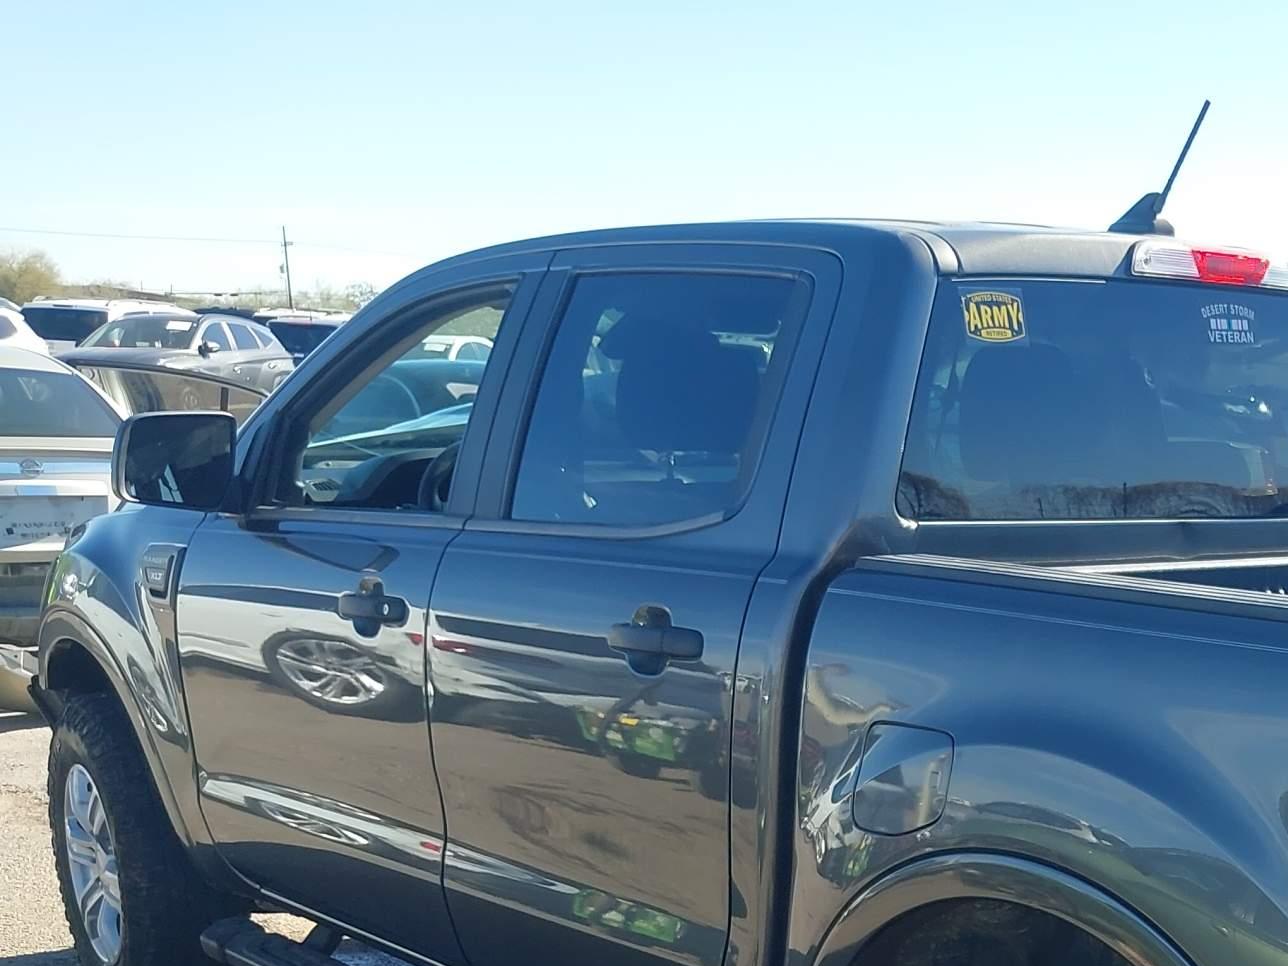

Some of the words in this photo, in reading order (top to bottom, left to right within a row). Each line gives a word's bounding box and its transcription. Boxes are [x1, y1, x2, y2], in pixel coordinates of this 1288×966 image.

[968, 302, 1019, 332] ARMY
[1200, 303, 1228, 318] DESERT
[1229, 304, 1255, 320] STORM
[1207, 330, 1255, 344] VETERAN
[150, 571, 164, 581] XLT
